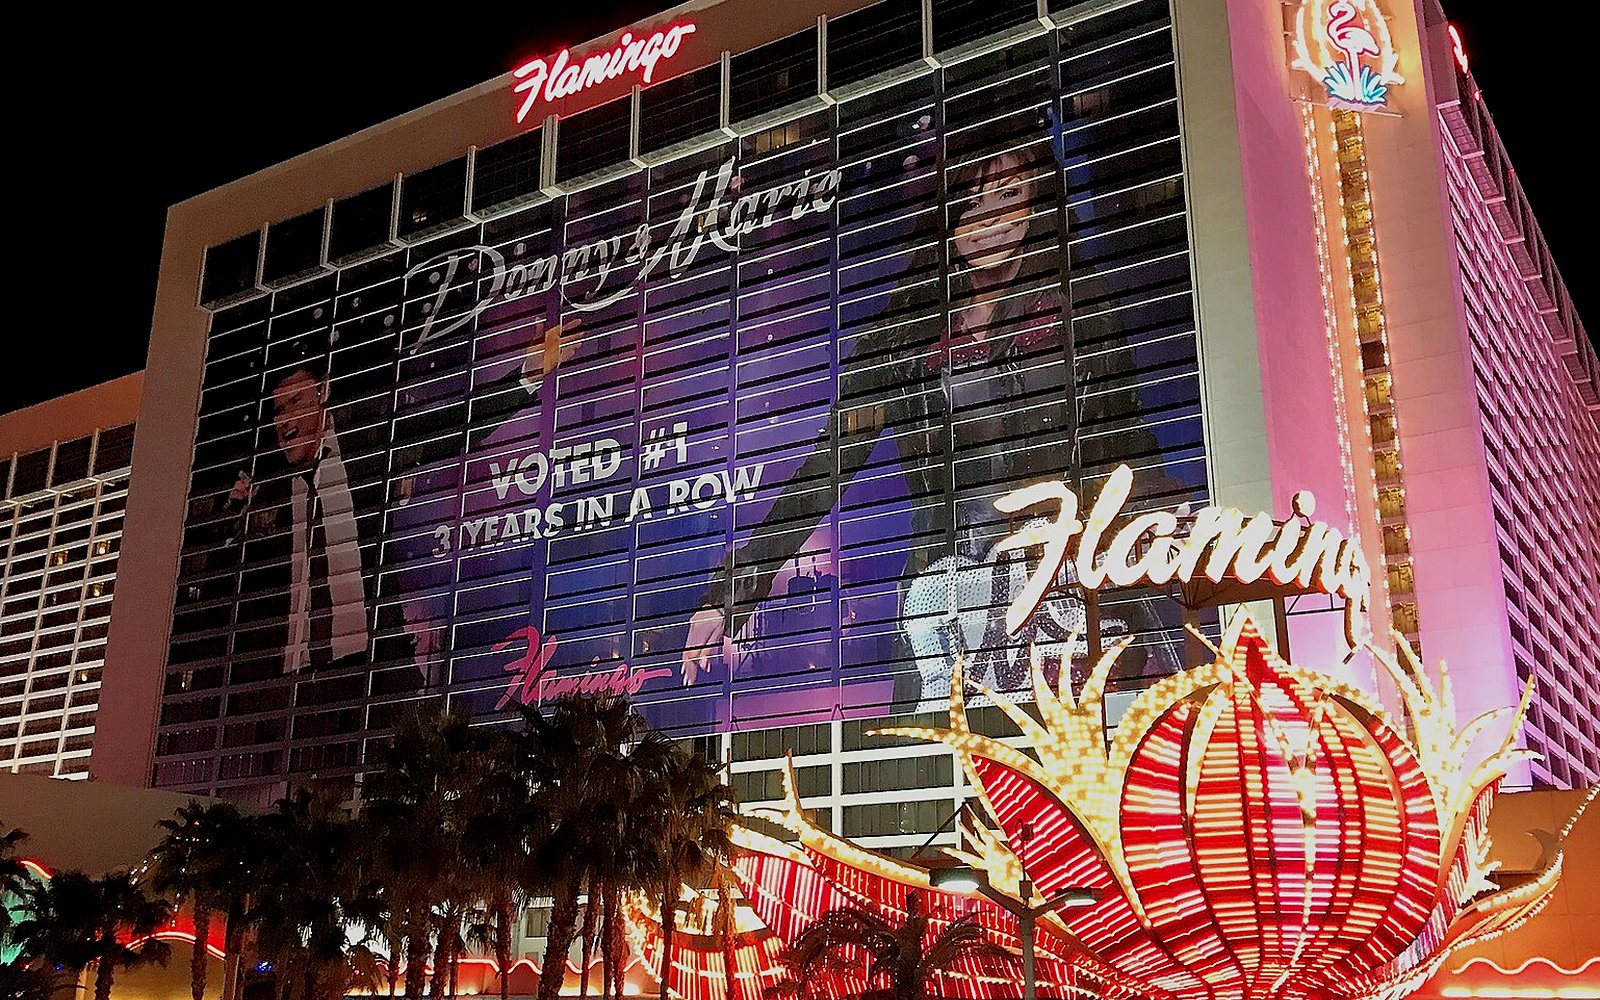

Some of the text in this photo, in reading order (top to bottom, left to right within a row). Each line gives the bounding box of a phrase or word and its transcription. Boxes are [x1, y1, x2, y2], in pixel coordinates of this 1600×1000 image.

[513, 23, 696, 123] Flamingo
[402, 236, 626, 356] Donny
[489, 421, 689, 500] VOTED #1
[432, 464, 765, 558] 3 YEARS IN A ROW
[491, 625, 673, 710] Flamingo
